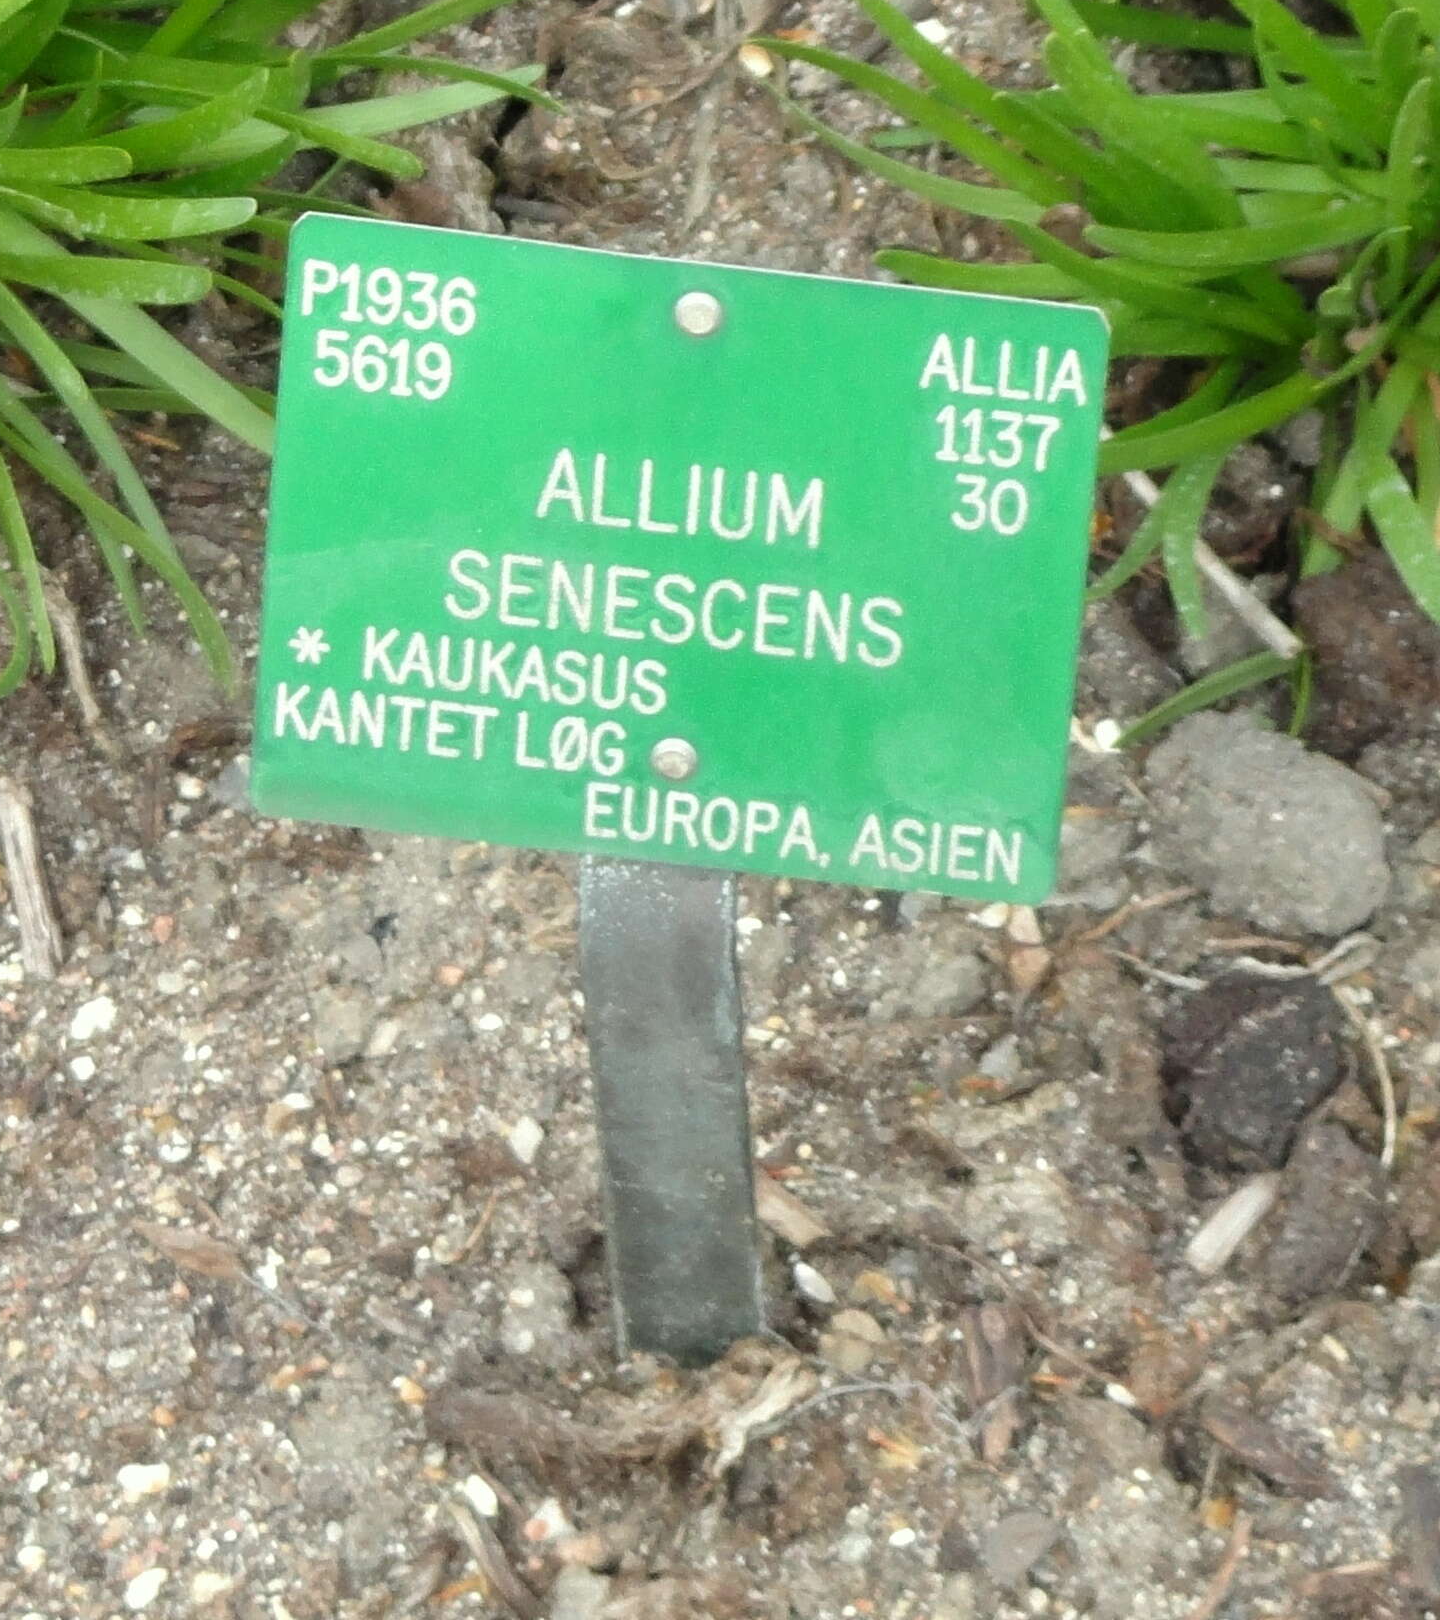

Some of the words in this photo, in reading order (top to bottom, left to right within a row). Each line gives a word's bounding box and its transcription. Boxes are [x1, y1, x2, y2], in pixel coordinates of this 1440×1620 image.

[299, 258, 478, 336] P1936
[312, 329, 454, 401] 5619
[918, 333, 1088, 407] ALLIA
[935, 405, 1062, 472] 1137
[535, 448, 826, 549] ALLIUM
[950, 473, 1030, 536] 30
[444, 548, 904, 668] SENESCENS
[361, 625, 668, 716] KAUKASUS
[273, 682, 500, 760] KANTET
[514, 711, 627, 777] LØG
[583, 782, 832, 871] EUROPA,
[848, 813, 1024, 887] ASIEN
